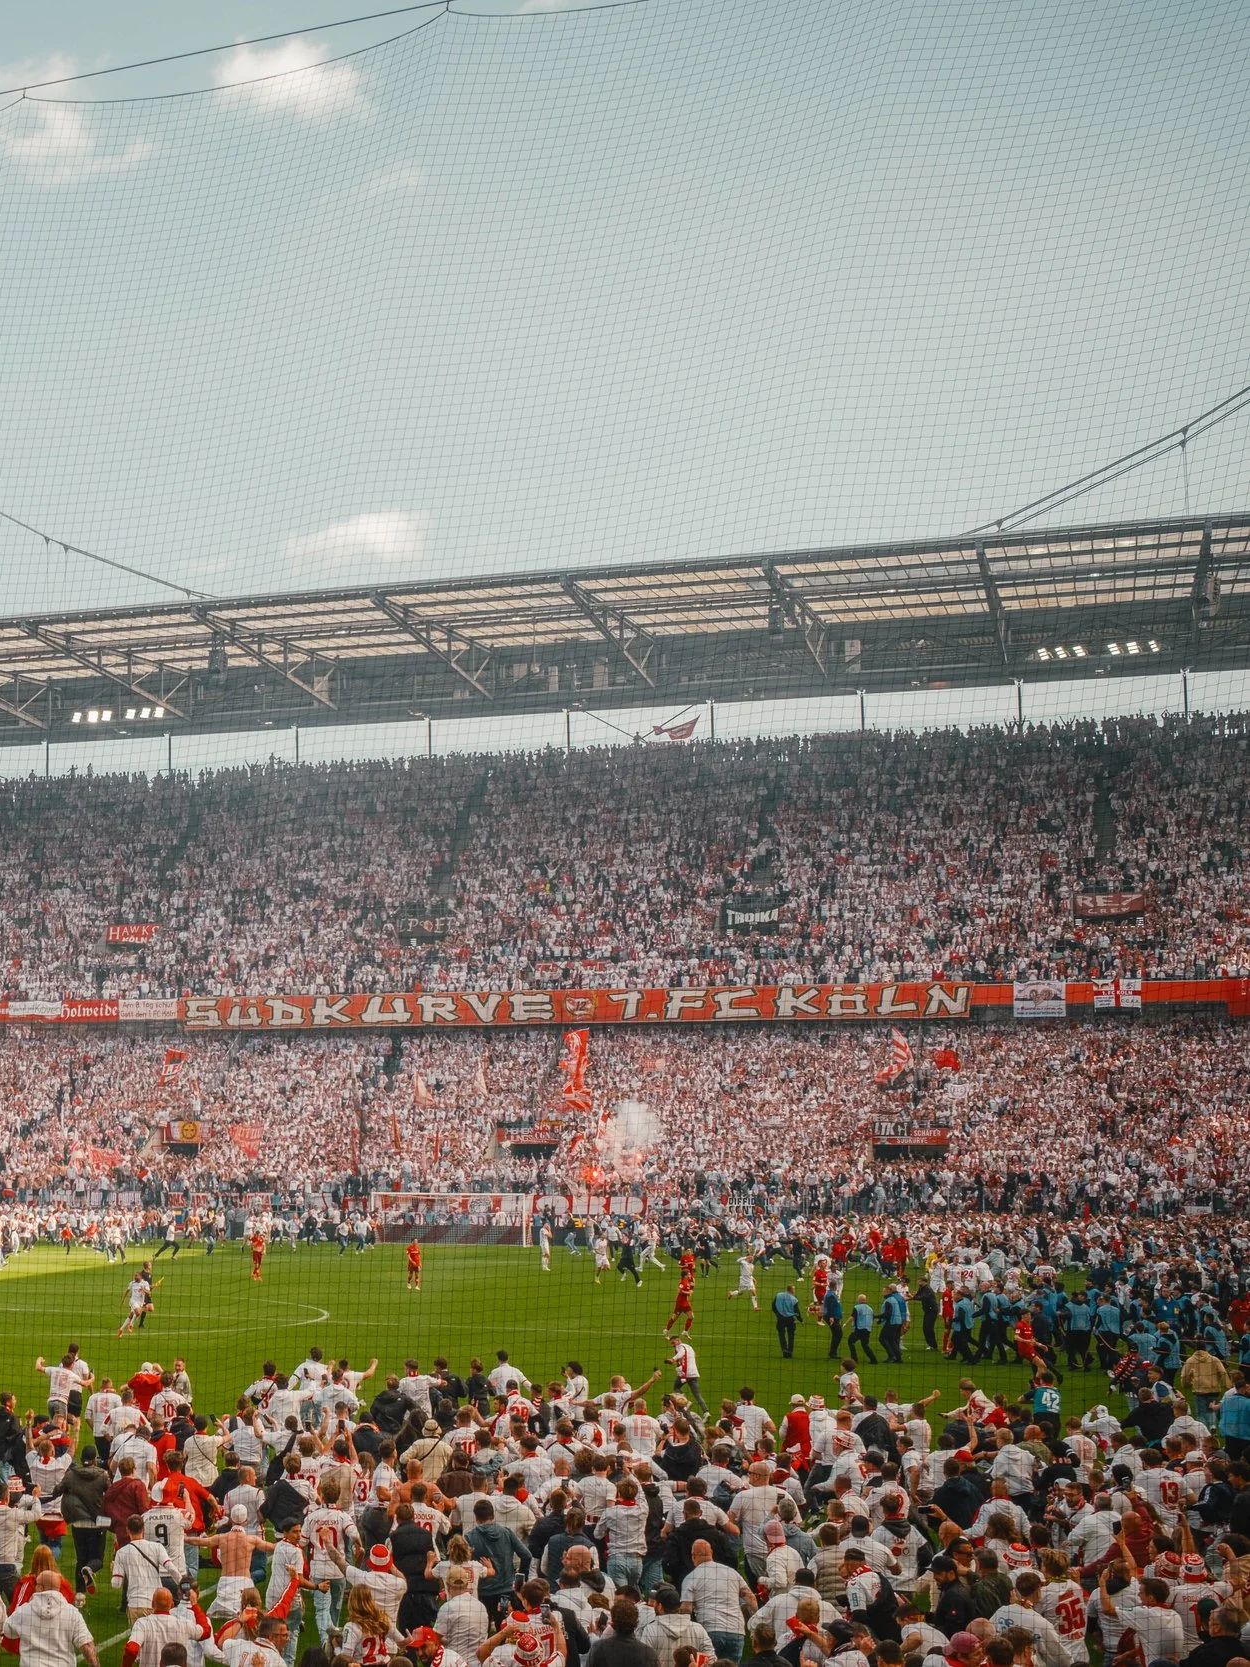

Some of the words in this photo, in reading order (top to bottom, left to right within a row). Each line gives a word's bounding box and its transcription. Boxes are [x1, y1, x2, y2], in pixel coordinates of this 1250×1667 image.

[60, 1002, 118, 1020] Holweide
[775, 984, 972, 1018] KÖLN
[162, 1404, 175, 1418] 10
[1042, 1391, 1060, 1410] 42
[154, 1523, 169, 1547] 9
[1055, 1598, 1086, 1635] 35
